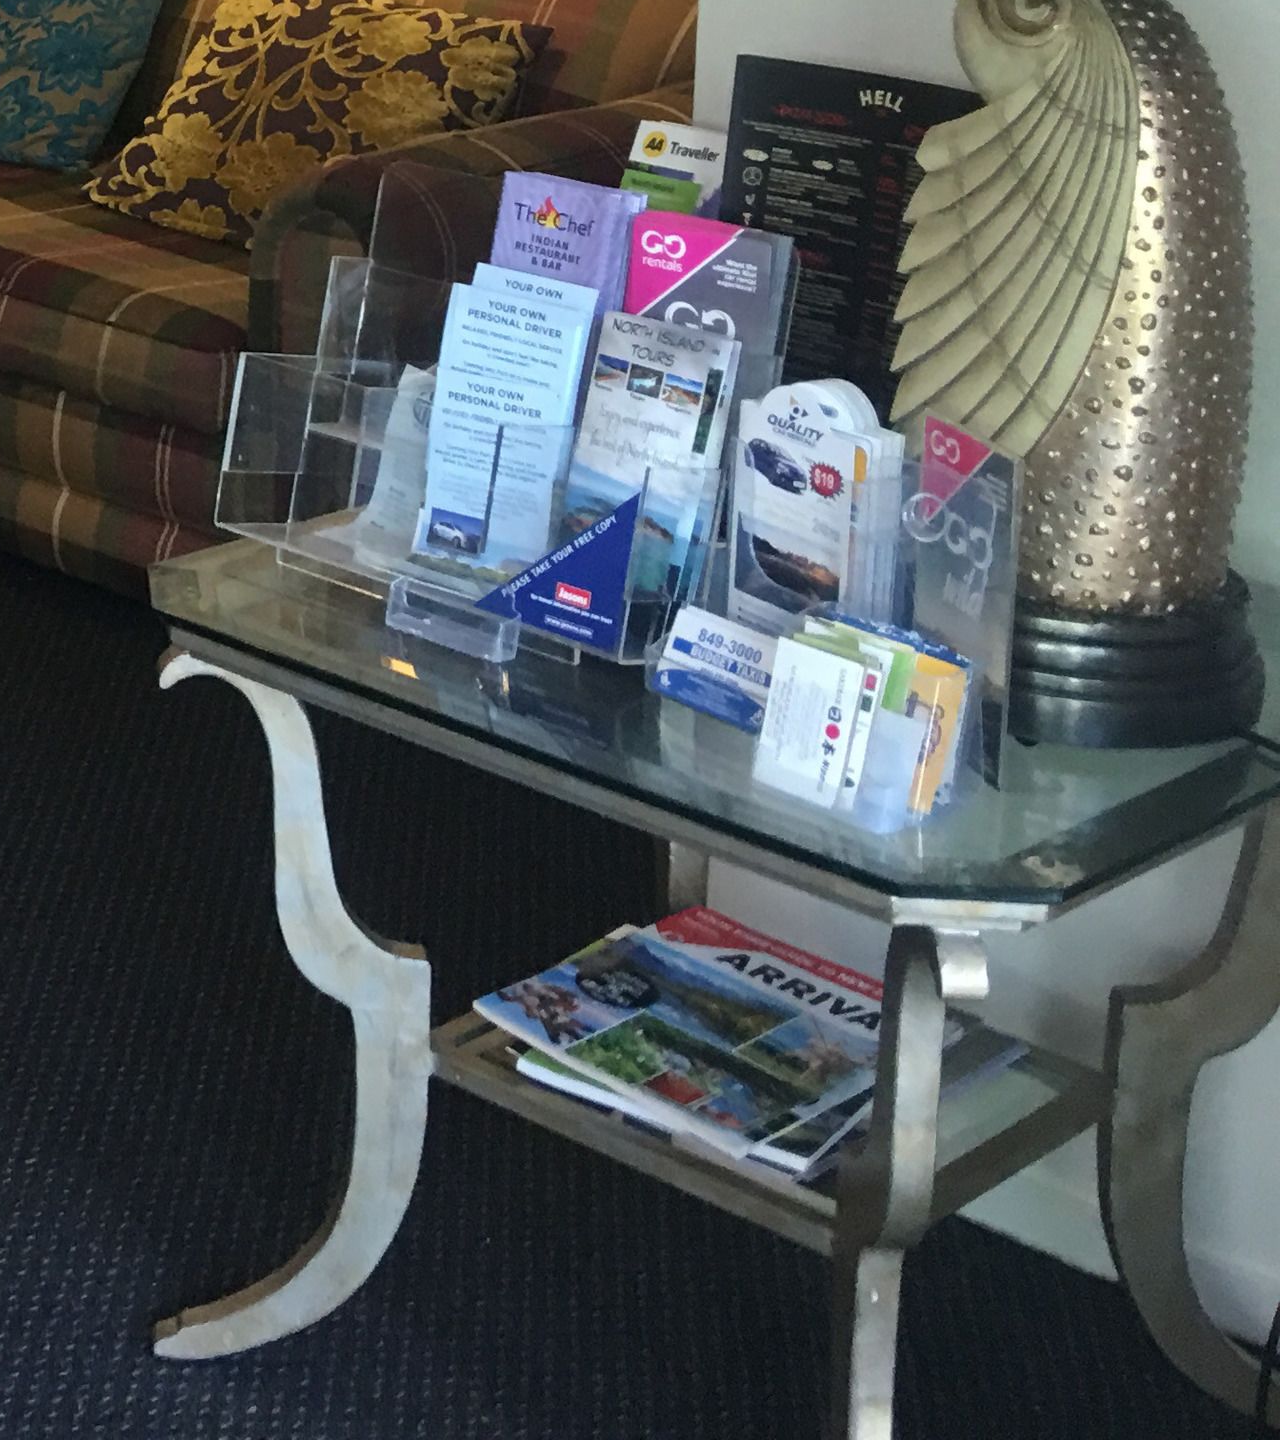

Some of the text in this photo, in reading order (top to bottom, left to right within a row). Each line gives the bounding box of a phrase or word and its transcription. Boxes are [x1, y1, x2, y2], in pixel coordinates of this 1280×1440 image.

[859, 89, 904, 113] HELL
[669, 141, 721, 162] Traveller
[514, 202, 596, 238] The Chef
[514, 240, 581, 266] RESTAURANT
[531, 233, 570, 251] INDIAN
[541, 259, 562, 272] BAR
[642, 256, 683, 273] rentals
[505, 279, 563, 300] YOUR OWN
[488, 299, 546, 322] YOUR OWN
[467, 308, 562, 339] PERSONAL DRIVER
[612, 317, 706, 353] NORTH ISLAND
[631, 344, 676, 368] TOURS
[467, 381, 525, 402] YOUR OWN
[448, 391, 542, 419] PERSONAL DRIVER
[767, 413, 825, 442] QUALITY
[814, 468, 835, 490] $19
[501, 514, 617, 598] PLEASE TAKE YOUR FREE COPY
[558, 587, 588, 606] Jasons
[698, 628, 763, 664] 849-3000
[691, 643, 732, 673] BUDGET
[737, 662, 767, 686] TAXIS
[716, 953, 883, 1030] ARRIVA
